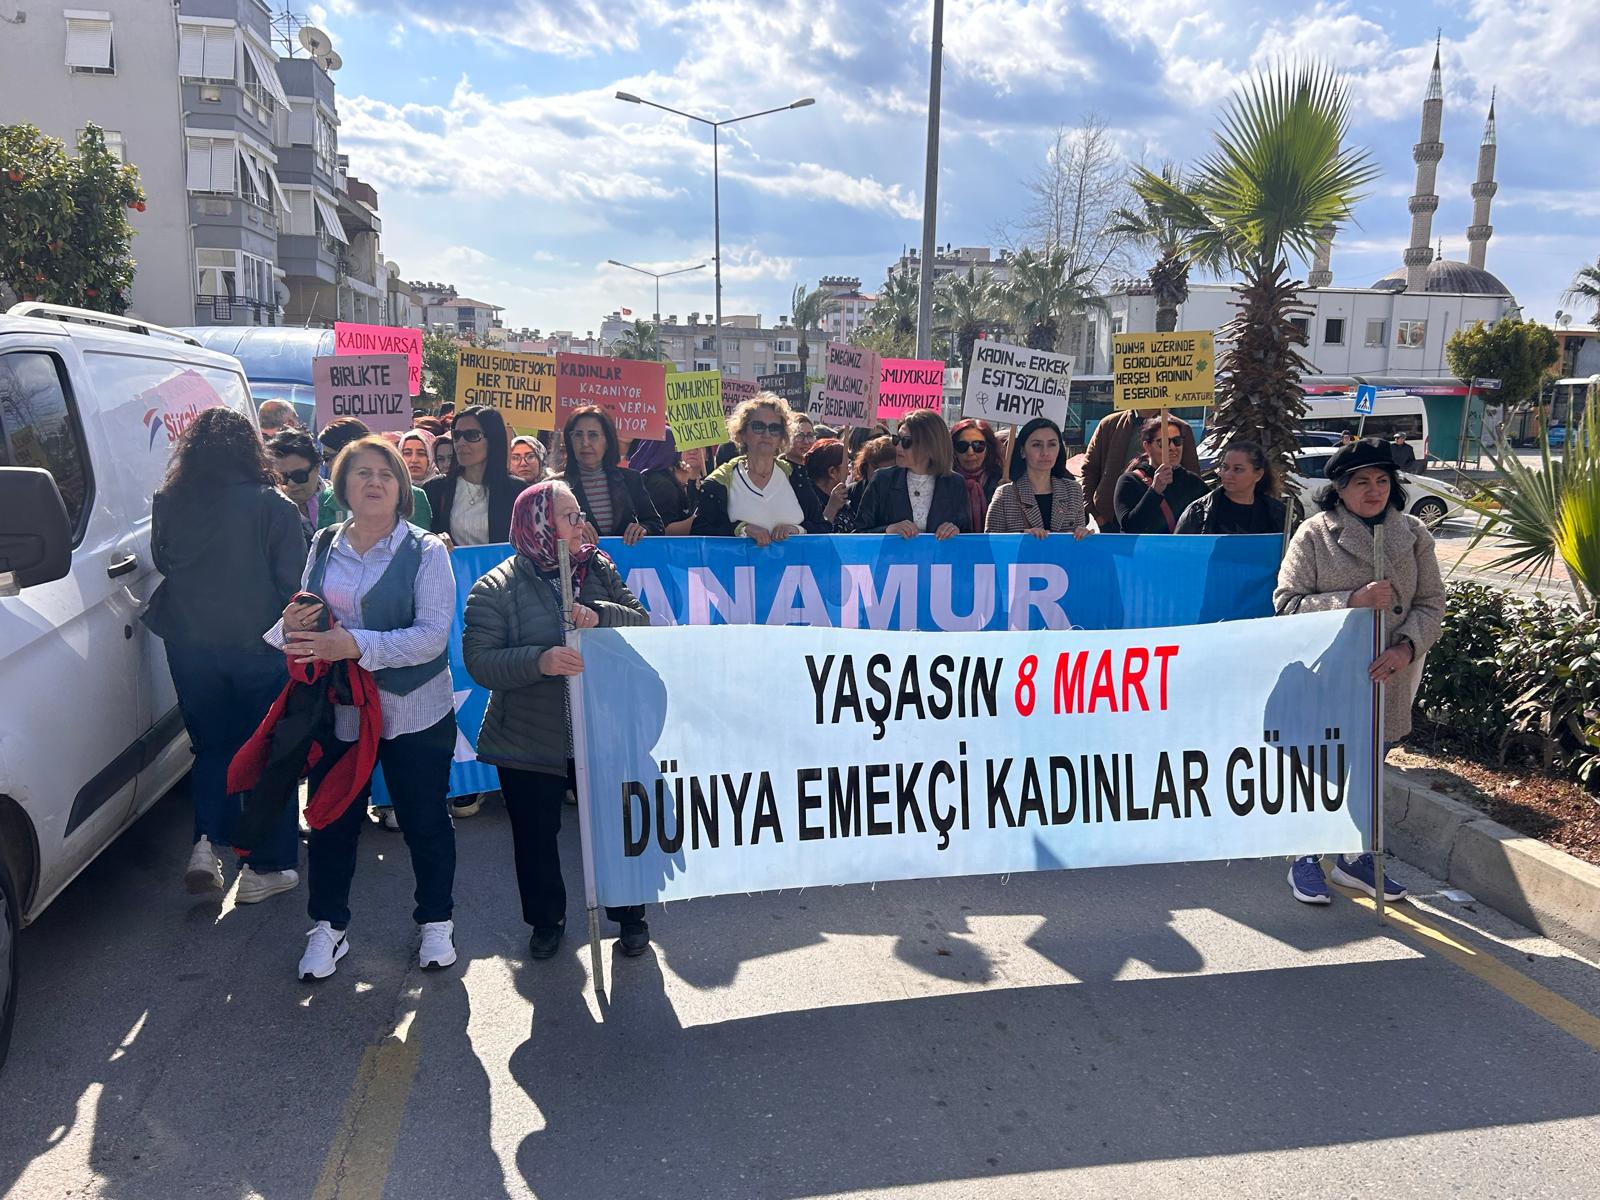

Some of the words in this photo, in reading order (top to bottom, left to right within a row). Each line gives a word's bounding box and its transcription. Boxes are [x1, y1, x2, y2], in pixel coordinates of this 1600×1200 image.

[338, 332, 376, 350] KADIN
[377, 335, 418, 354] VARSA
[460, 353, 490, 369] HAKLI
[492, 356, 528, 373] ŞİDDET
[560, 362, 622, 380] KADINLAR
[977, 346, 1015, 366] KADIN
[1015, 360, 1027, 368] ve
[1029, 355, 1070, 375] ERKEK
[329, 365, 391, 387] BİRLİKTE
[476, 372, 501, 388] HER
[505, 375, 541, 392] TÜRLÜ
[1116, 372, 1150, 385] HERŞEY
[1156, 369, 1193, 383] KADININ
[580, 382, 642, 398] KAZANIYOR
[666, 377, 720, 401] CUMHURİYET
[332, 394, 403, 417] GÜÇLÜYÜZ
[515, 393, 553, 413] HAYIR
[667, 400, 724, 422] KADINLARLA
[825, 396, 865, 419] BEDENİMİZ
[995, 392, 1045, 417] HAYIR
[673, 419, 721, 443] YÜKSELİR
[622, 564, 1072, 632] ANAMUR
[805, 653, 1003, 741] YAŞASIN
[1014, 654, 1039, 717] 8
[1053, 645, 1180, 715] MART
[621, 759, 784, 857] DÜNYA
[797, 741, 970, 851] EMEKÇİ
[986, 750, 1212, 829] KADINLAR
[1226, 728, 1345, 816] GÜNÜ
